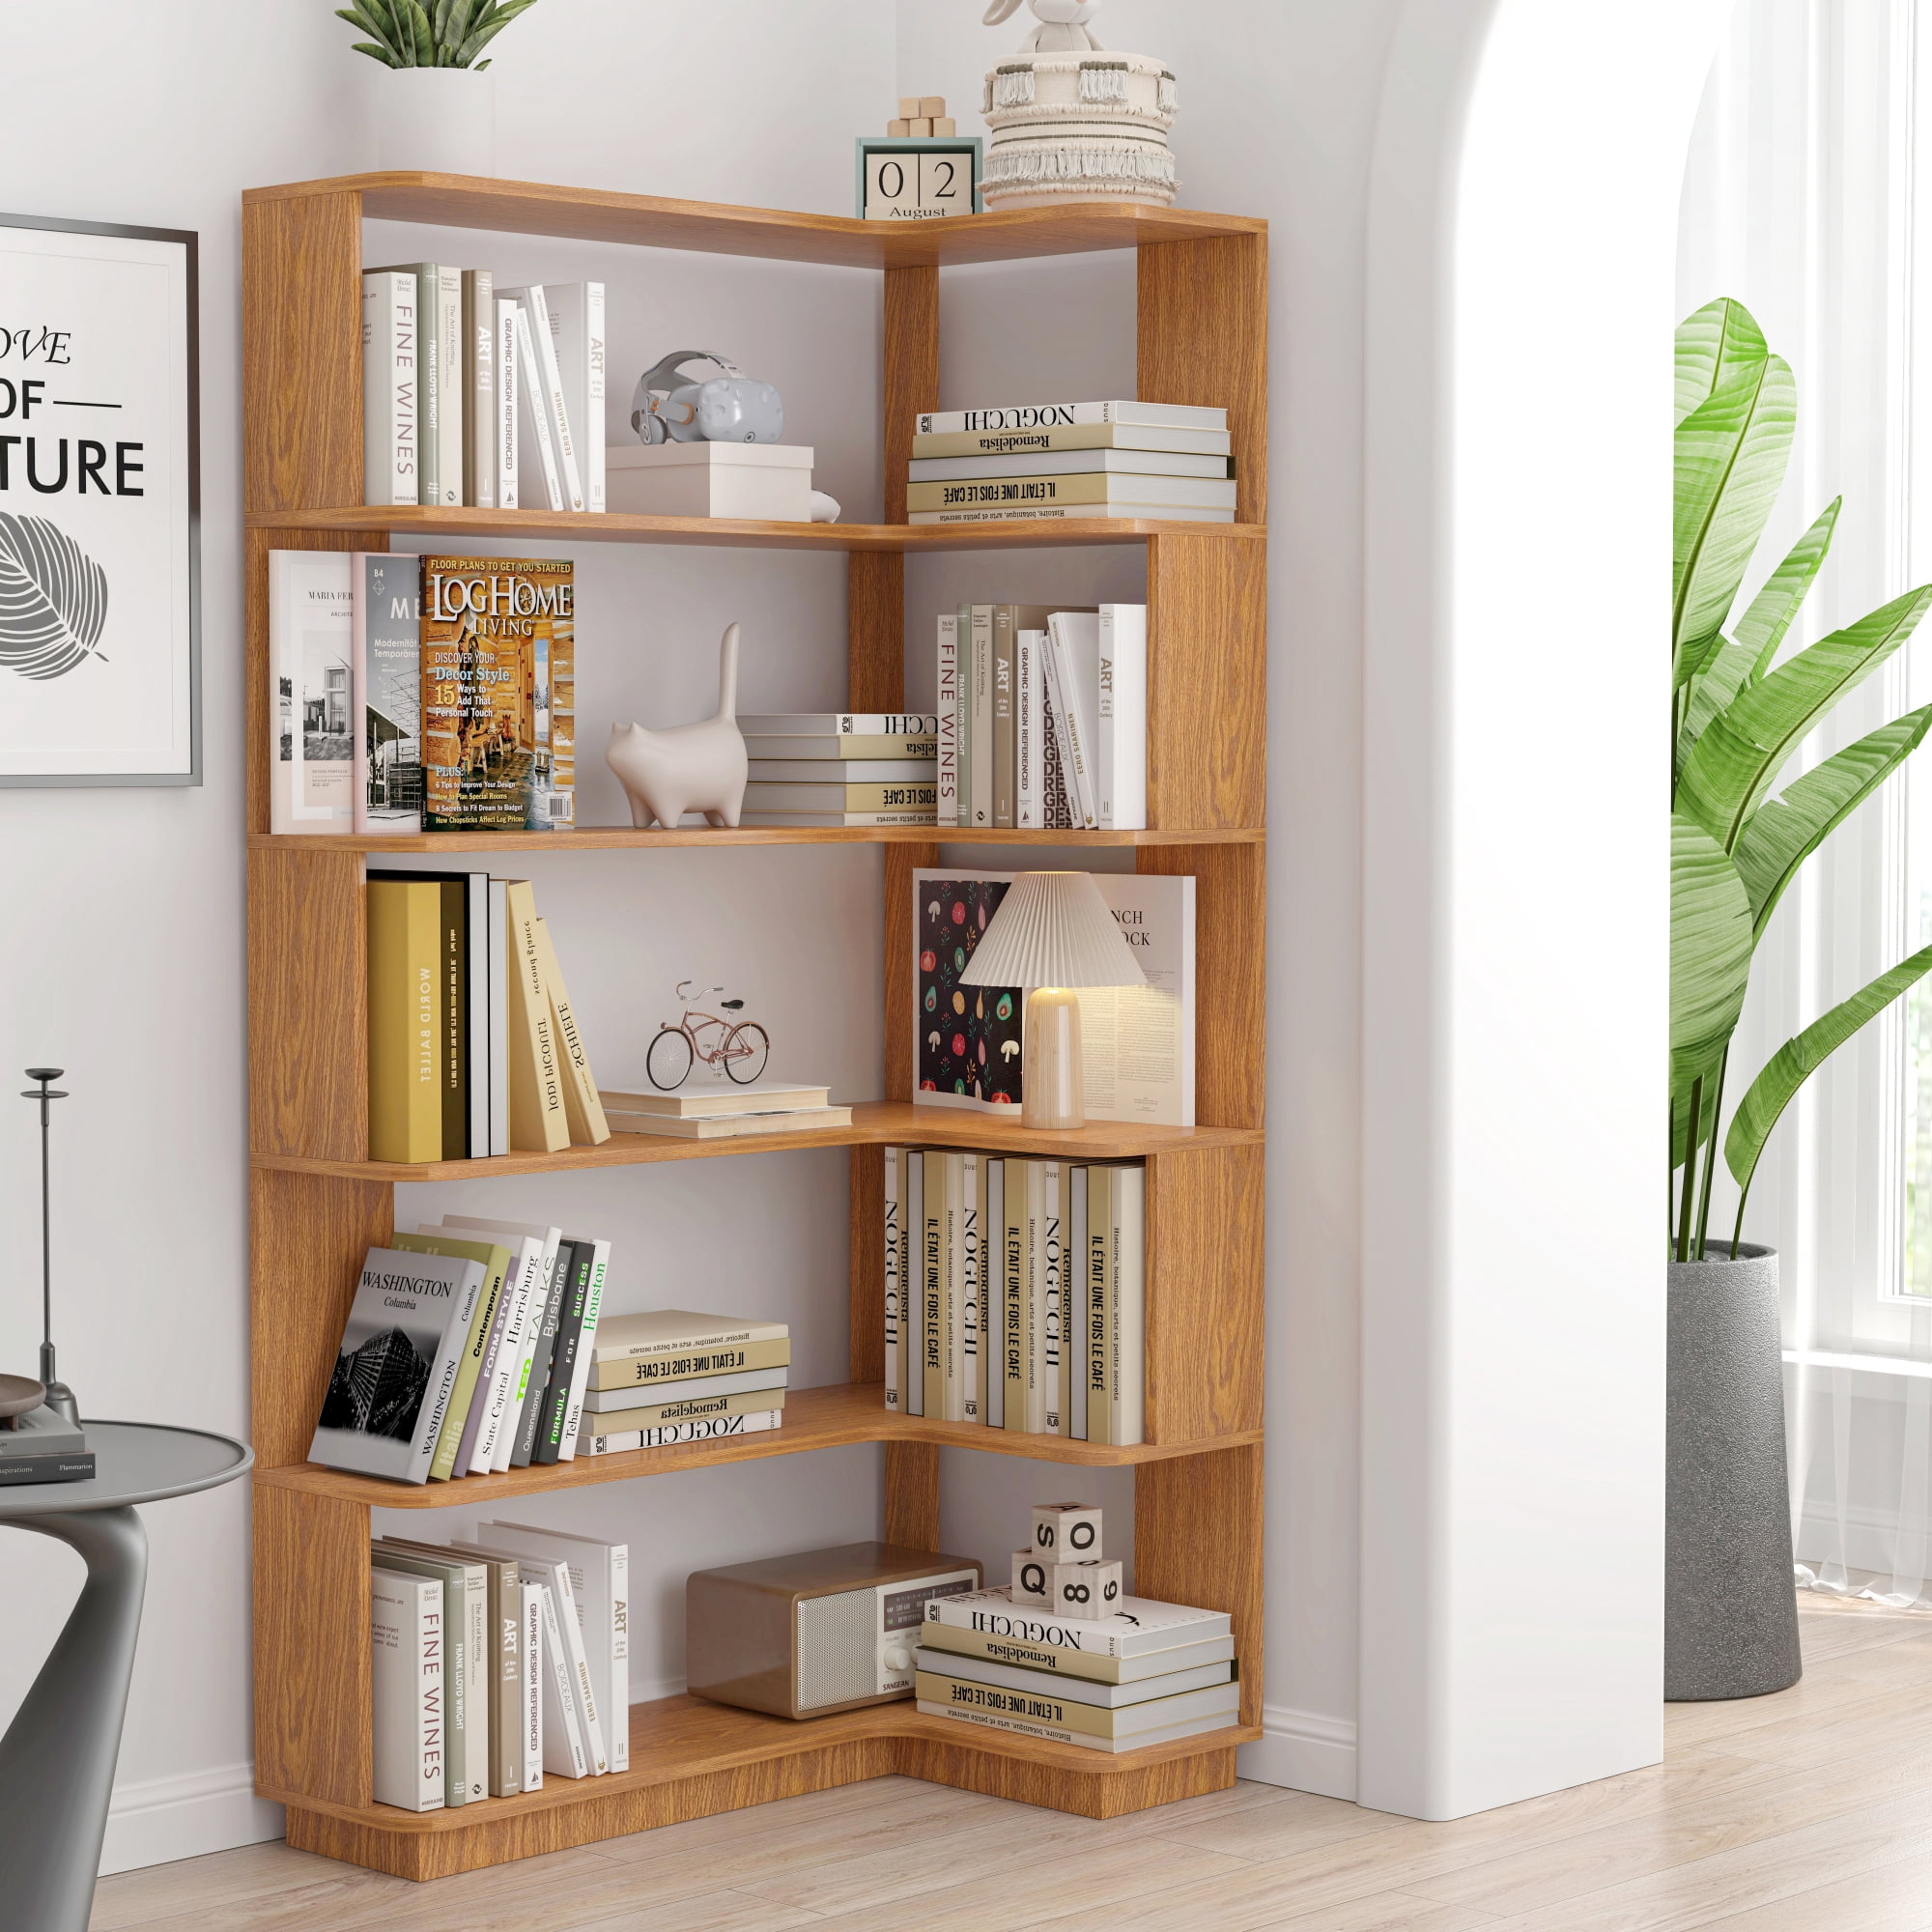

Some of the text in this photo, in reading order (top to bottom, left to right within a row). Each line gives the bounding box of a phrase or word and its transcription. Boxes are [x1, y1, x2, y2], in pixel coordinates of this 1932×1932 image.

[878, 161, 956, 198] 0 2
[889, 207, 947, 219] August
[396, 305, 412, 367] FINE
[478, 326, 492, 364] ART
[590, 337, 604, 374] ART
[504, 318, 514, 470] GRAPHIC DESIGN REFERENCED
[396, 382, 413, 474] WINES
[963, 405, 1075, 432] NOGUCHI
[980, 435, 1050, 450] Remodelista
[943, 482, 1055, 506] IL ÉTAIT UNE FOIS LE CAFÉ
[431, 559, 571, 573] FLOOR PLANS TO GET YOU STARTED
[308, 591, 335, 600] MARIA
[473, 618, 533, 637] LIVING
[435, 651, 495, 664] DISCOVER YOUR
[997, 657, 1009, 693] ART
[1100, 657, 1113, 693] ART
[435, 667, 510, 685] Decor Style
[435, 684, 487, 705] 15 Ways to
[457, 696, 491, 705] Add That
[436, 708, 493, 718] Personal Touch
[941, 644, 955, 798] FINE WINES
[883, 789, 936, 808] FOIS LE CAFÉ
[361, 1270, 453, 1298] WASHINGTON
[885, 1200, 897, 1345] NOGUCHI
[964, 1207, 978, 1355] NOGUCHI
[384, 1296, 417, 1310] Columbia
[1046, 1216, 1060, 1366] NOGUCHI
[484, 1280, 514, 1378] FORM STYLE
[1092, 1236, 1105, 1392] IL ÉTAIT UNE FOIS LE CAFÉ
[482, 1255, 539, 1455] State Capital Harrisburg
[523, 1262, 567, 1452] Queensland Brisbane
[549, 1263, 589, 1445] FORMULA FOR SUCCESS
[565, 1263, 607, 1439] Tehas Houston
[421, 1285, 477, 1455] WASHINGTON Columbia
[439, 1275, 501, 1466] Italia Contemporan
[516, 1357, 532, 1403] TED
[1037, 1522, 1055, 1548] S
[1020, 1563, 1046, 1596] Q
[614, 1600, 627, 1634] ART
[971, 1611, 1082, 1651] NOGUCHI
[423, 1613, 440, 1676] FINE
[503, 1618, 518, 1654] ART
[529, 1649, 538, 1685] DESIGN
[987, 1642, 1057, 1668] Remodelista
[952, 1685, 1063, 1722] IL ÉTAIT UNE FOIS LE CAFÉ
[423, 1687, 440, 1779] WINES
